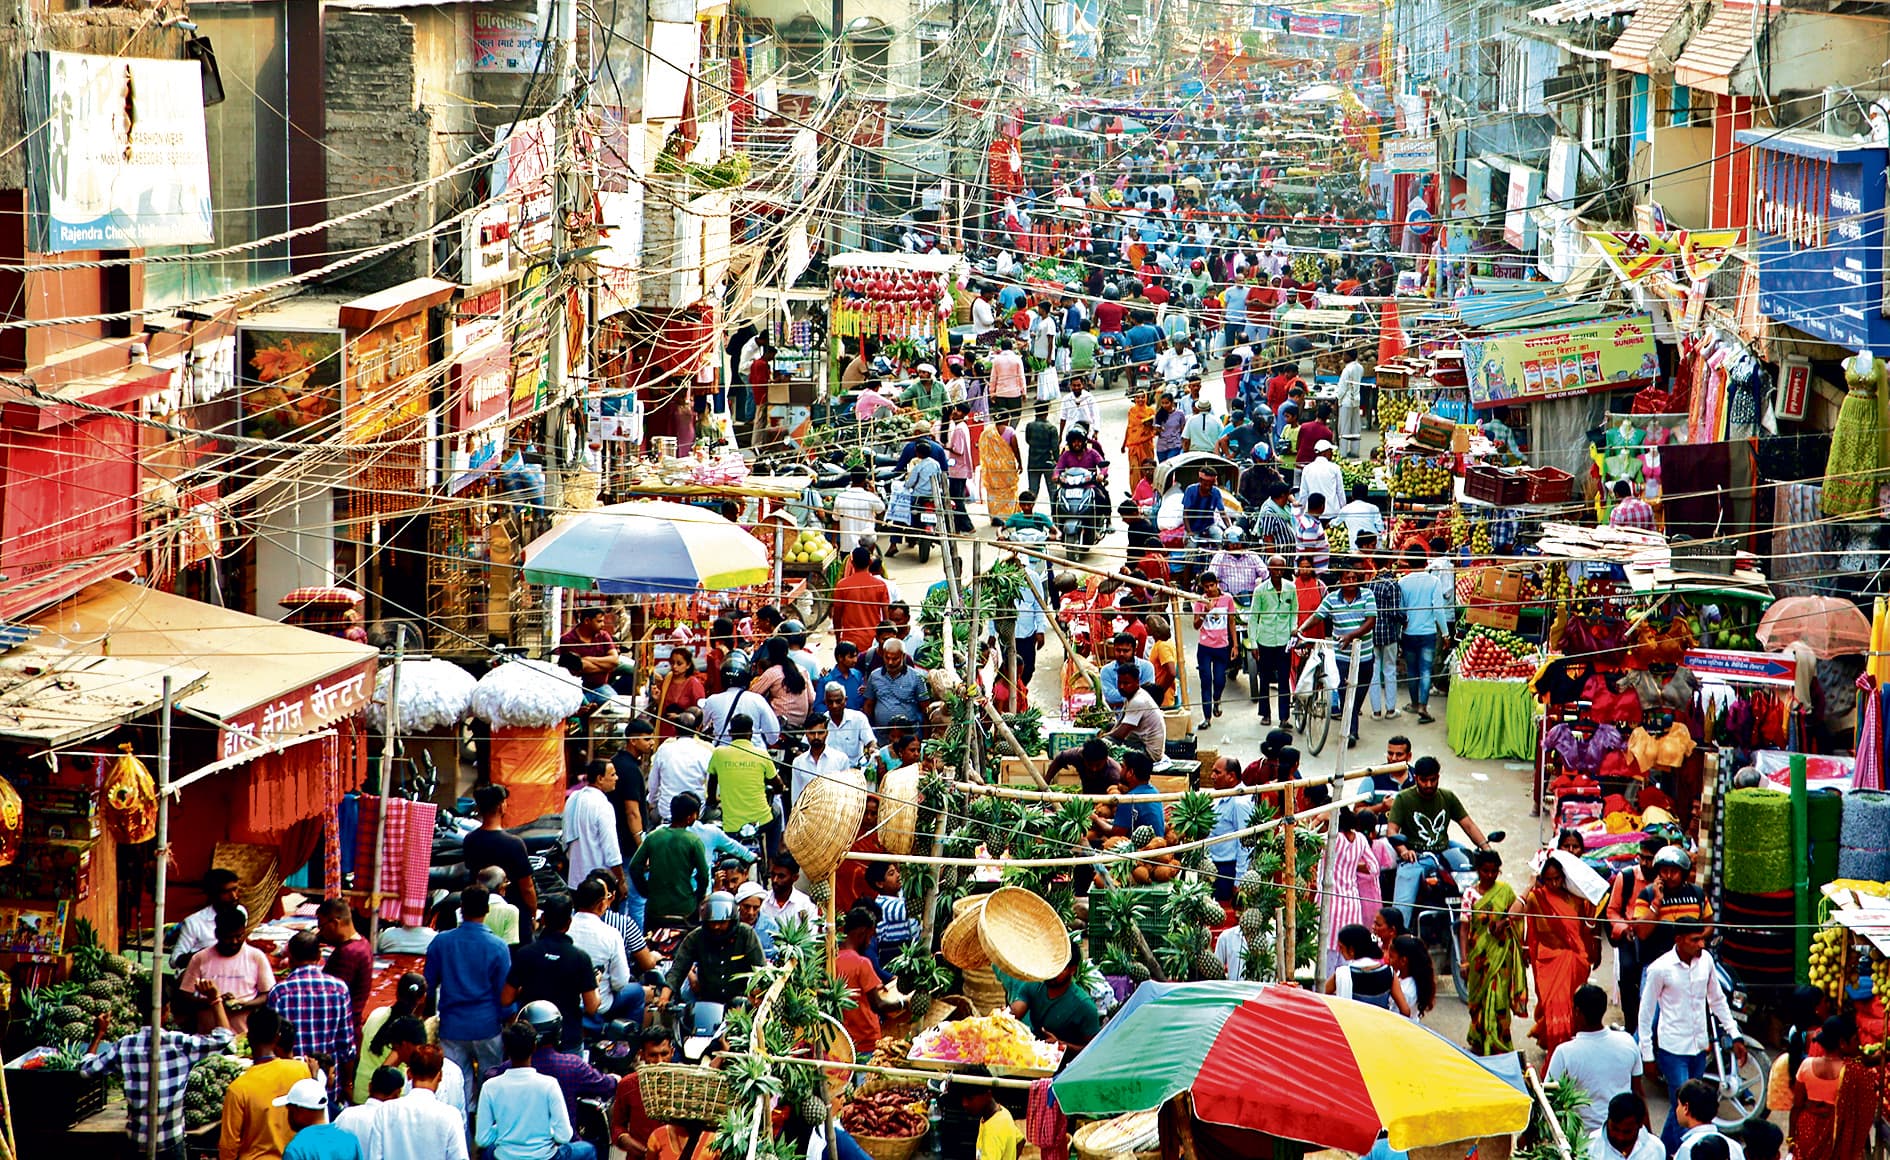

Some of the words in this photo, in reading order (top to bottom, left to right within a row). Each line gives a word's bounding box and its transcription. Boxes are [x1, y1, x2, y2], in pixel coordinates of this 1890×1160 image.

[1756, 188, 1821, 253] Crompton
[61, 225, 102, 244] Rajendra
[1493, 263, 1522, 280] किराना
[1613, 336, 1645, 347] SUNRISE
